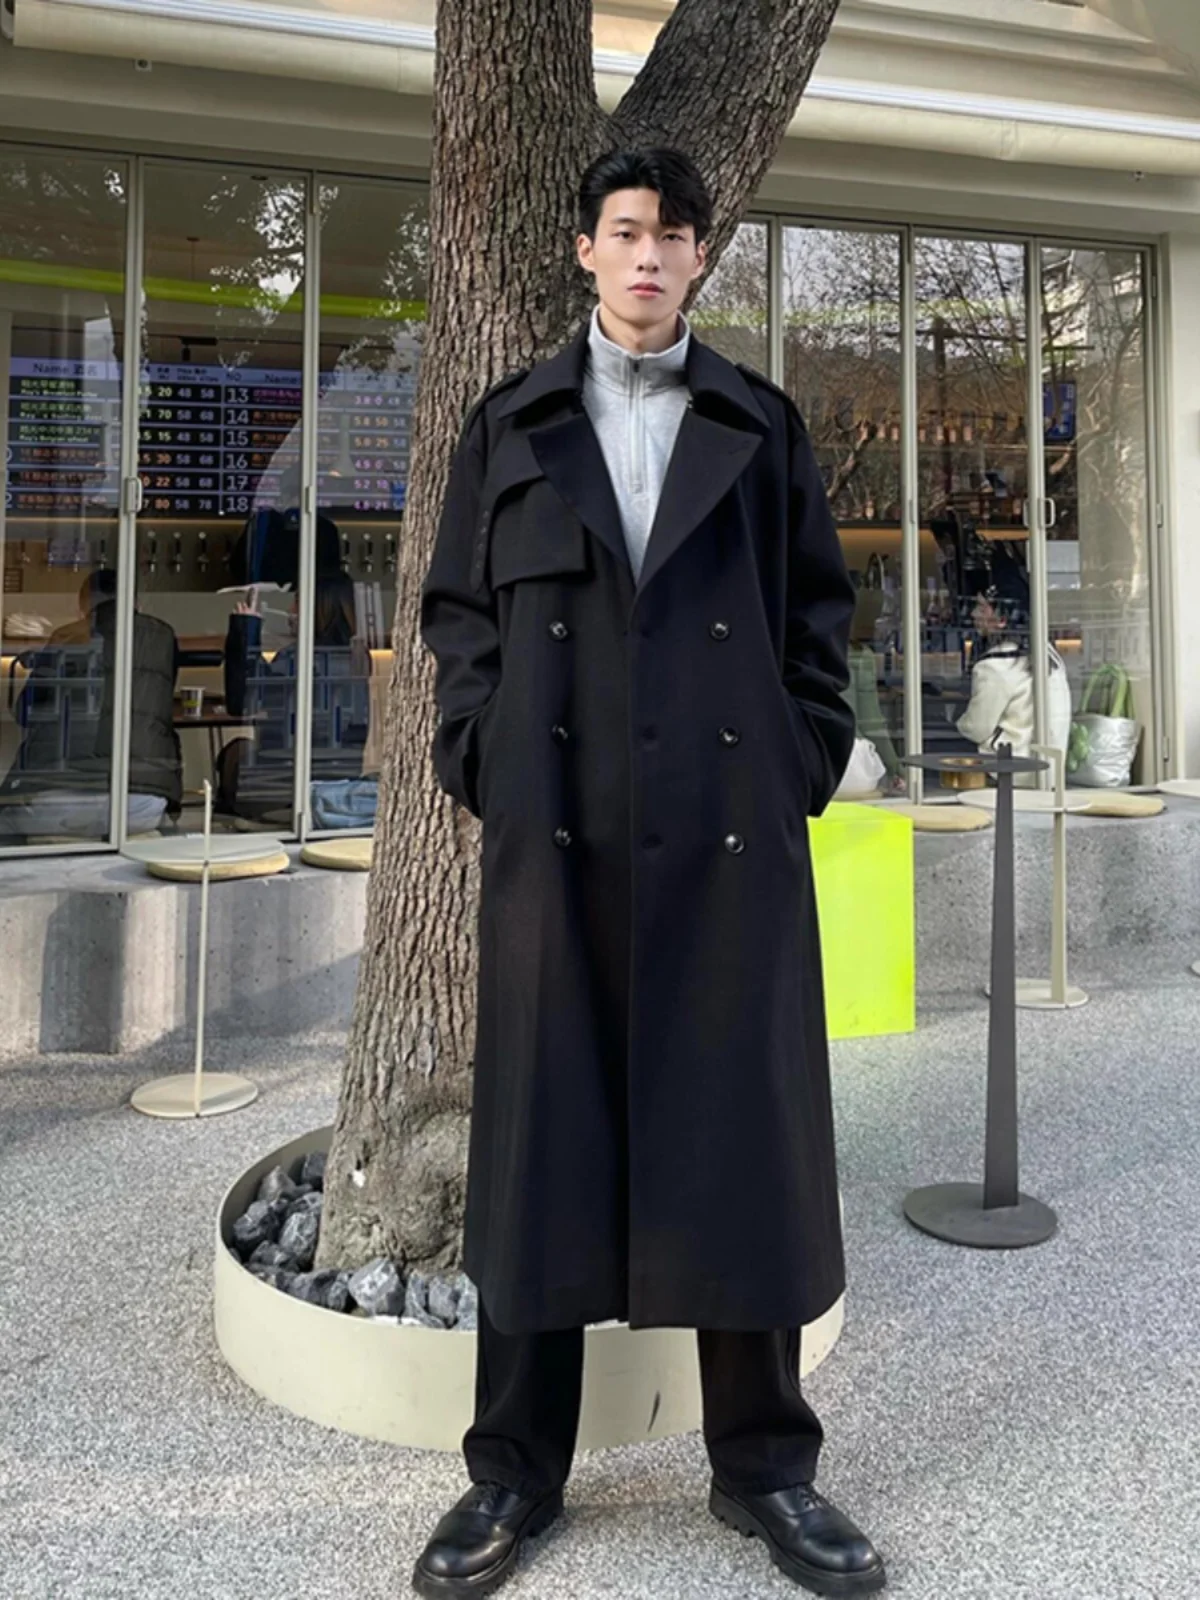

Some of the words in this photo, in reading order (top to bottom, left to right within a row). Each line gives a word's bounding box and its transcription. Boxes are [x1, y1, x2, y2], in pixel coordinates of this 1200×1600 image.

[32, 362, 69, 374] Name
[158, 385, 172, 397] 20
[227, 387, 249, 403] 13
[158, 409, 172, 419] 70
[227, 409, 249, 424] 14
[158, 430, 172, 441] 15
[227, 431, 249, 446] 15
[226, 454, 248, 469] 16
[156, 476, 170, 487] 22
[226, 475, 248, 490] 17
[226, 496, 249, 513] 18
